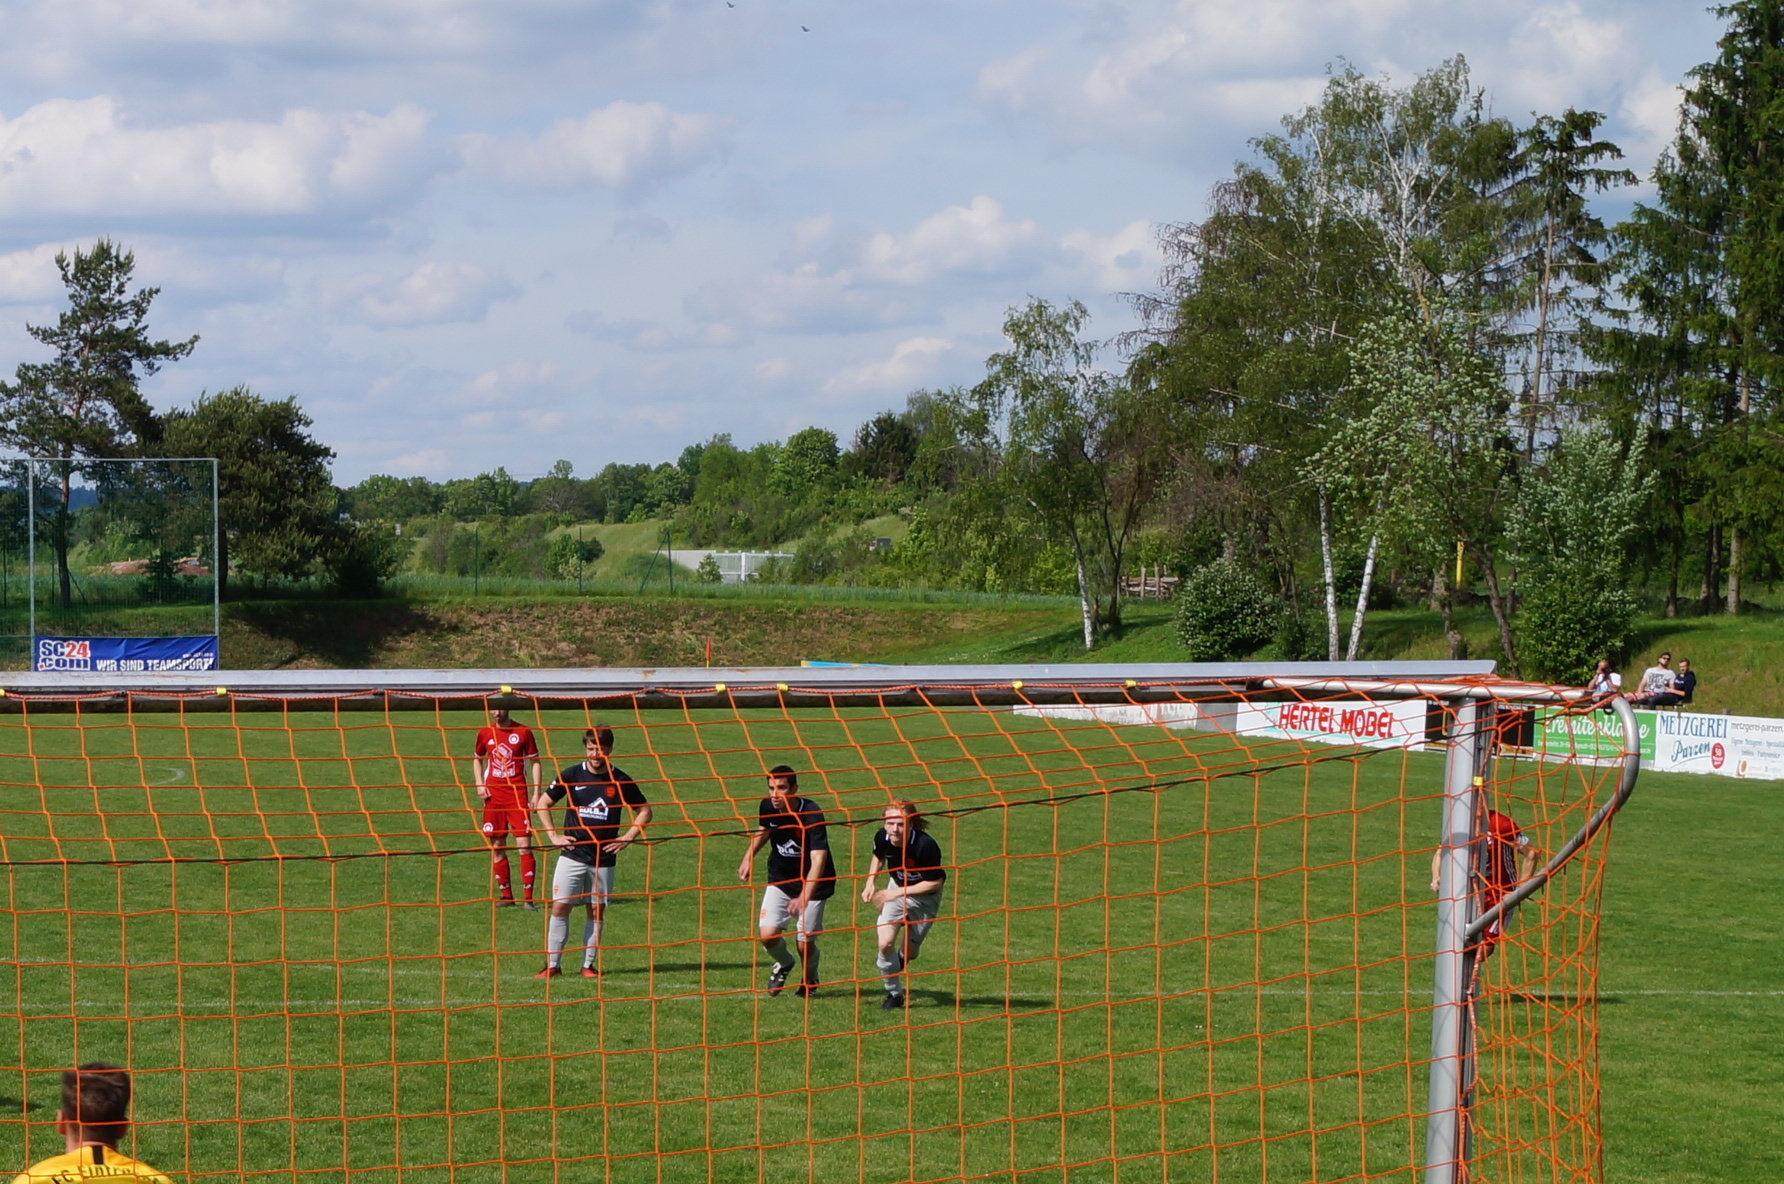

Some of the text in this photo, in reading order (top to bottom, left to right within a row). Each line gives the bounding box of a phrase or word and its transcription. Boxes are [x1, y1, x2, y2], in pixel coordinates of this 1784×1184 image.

[39, 640, 91, 658] SC24
[37, 657, 91, 671] .com
[96, 657, 214, 672] WIR SIND TEAMSPORT!
[1279, 704, 1334, 733] HERTEL
[1659, 714, 1728, 739] METZGEREI
[1671, 739, 1711, 762] Parzen
